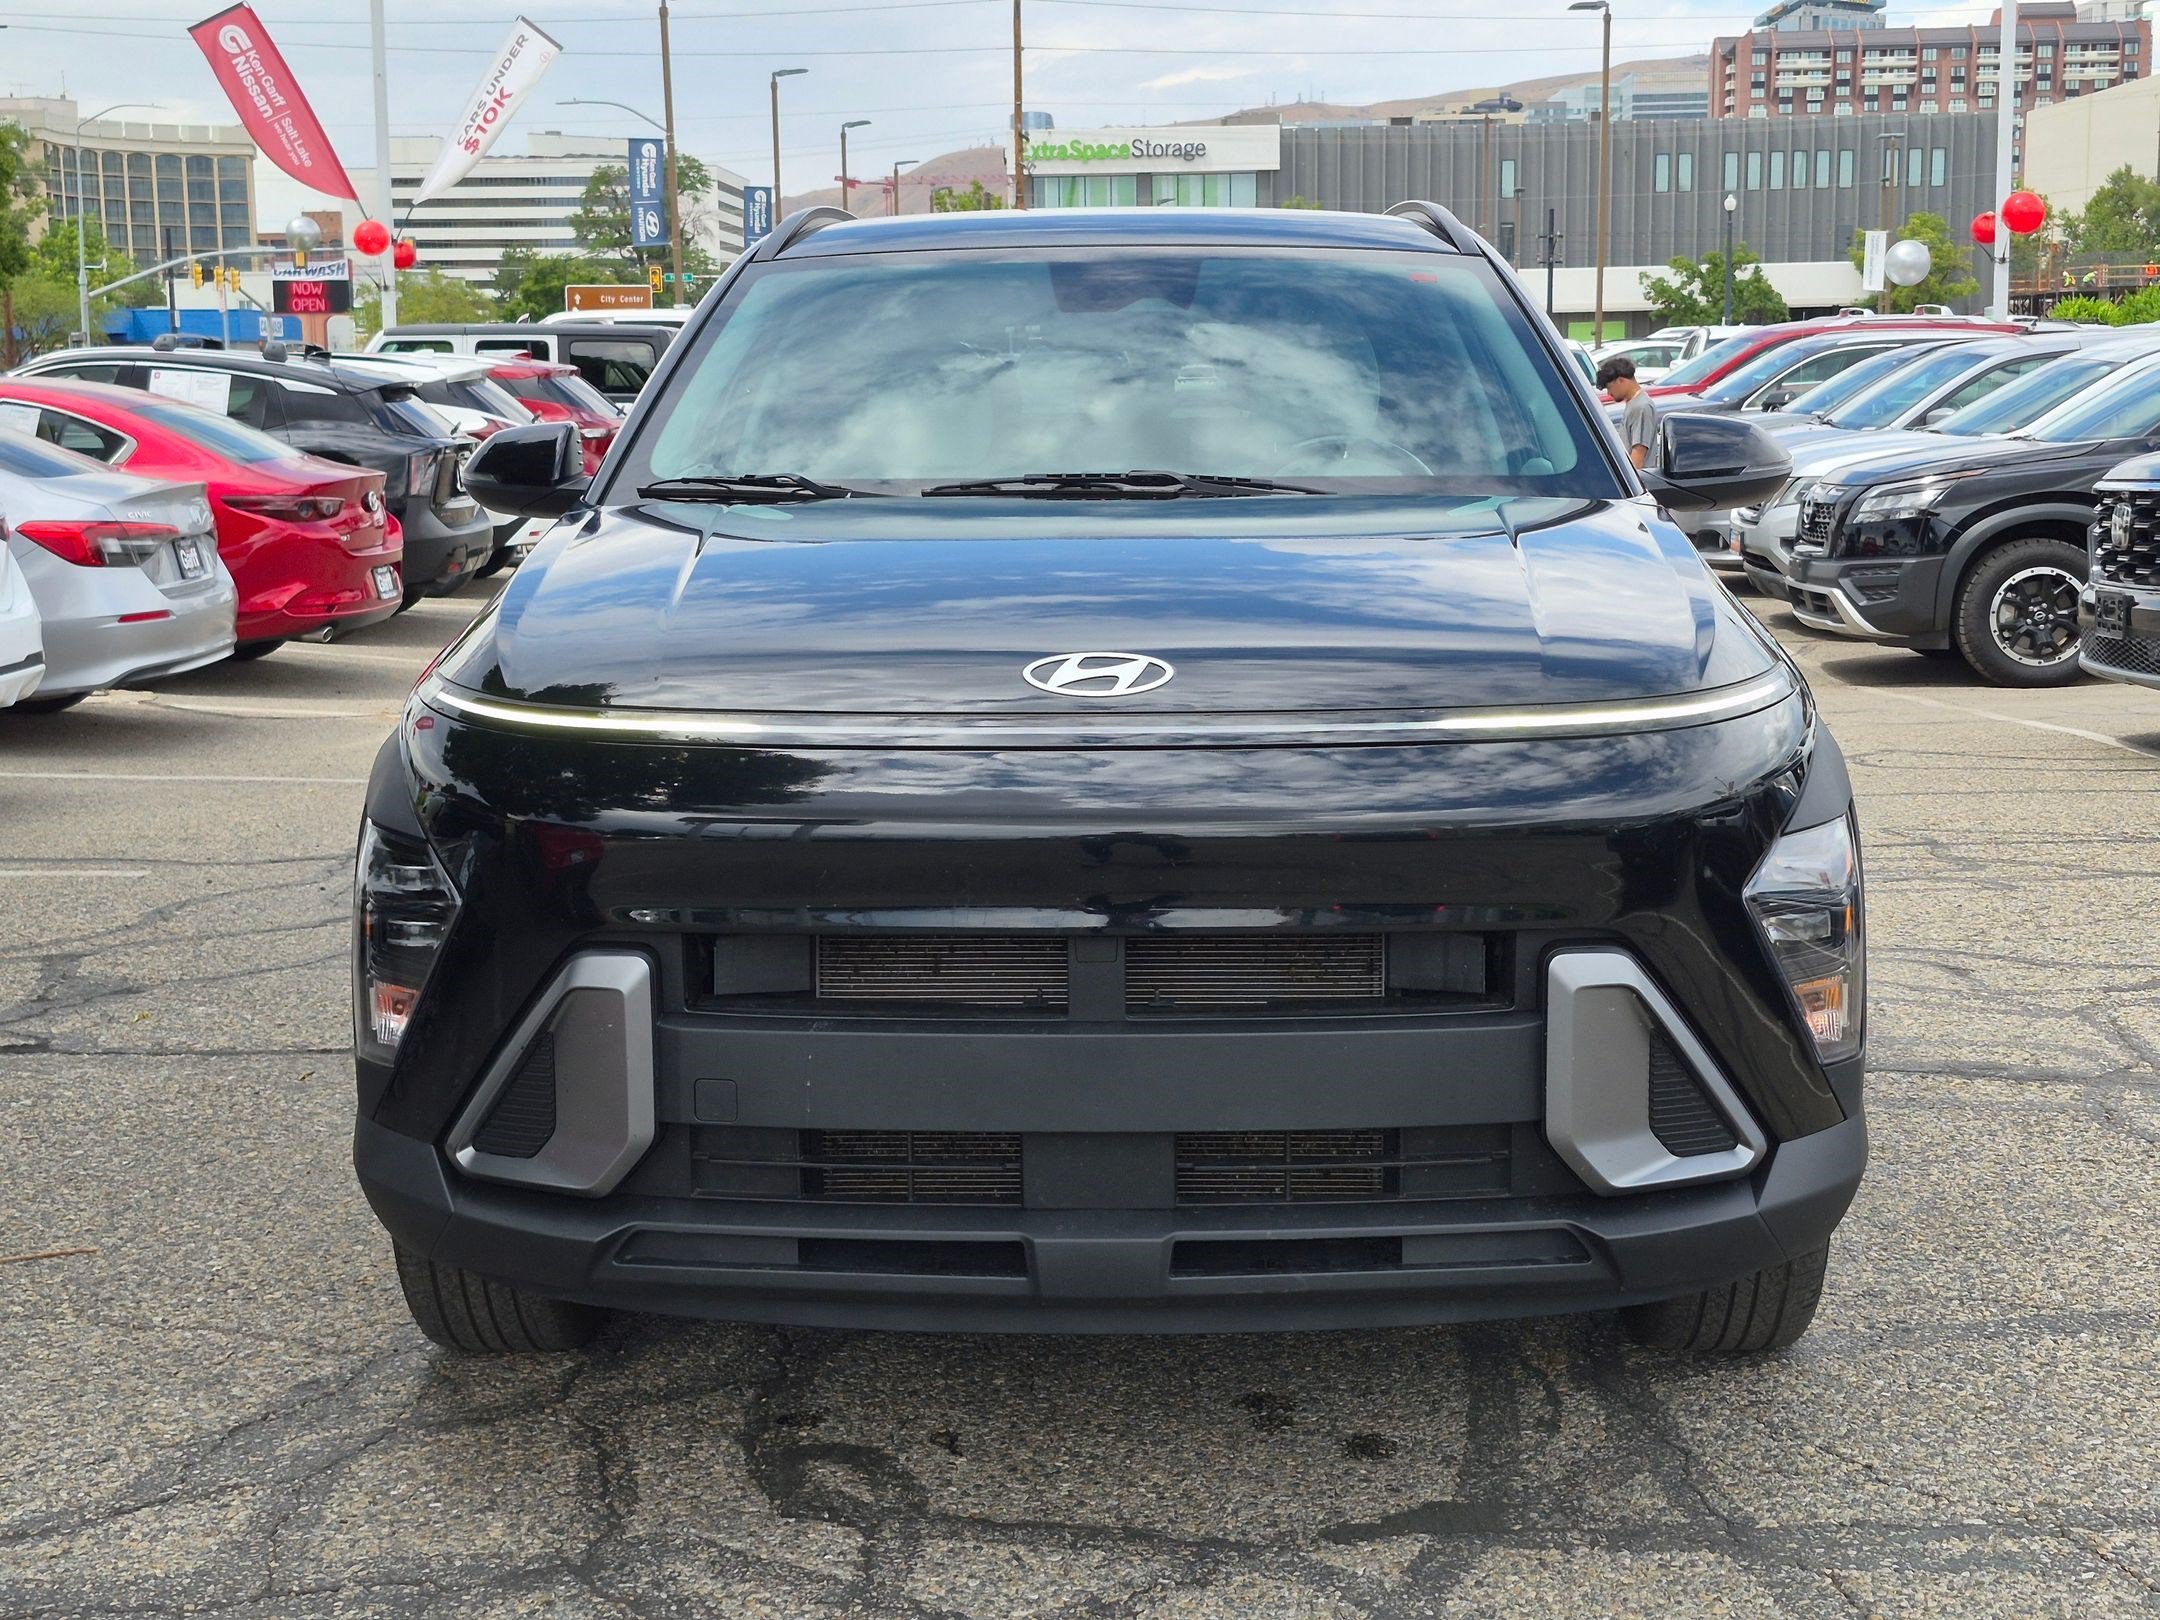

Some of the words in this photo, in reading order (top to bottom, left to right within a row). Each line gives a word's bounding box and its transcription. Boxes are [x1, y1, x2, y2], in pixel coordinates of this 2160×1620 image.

[231, 55, 274, 119] Nissan
[245, 50, 266, 77] Ken
[261, 75, 287, 109] Garff
[457, 99, 487, 146] CARS
[486, 33, 529, 96] UNDER
[464, 86, 514, 155] $10K
[278, 131, 292, 152] hear
[288, 150, 300, 166] you
[281, 116, 299, 140] Salt
[294, 136, 313, 168] Lake
[1131, 138, 1207, 161] Storage
[641, 158, 650, 197] Hyundai
[305, 263, 346, 276] WASH
[292, 282, 323, 295] NOW
[292, 298, 325, 311] OPEN
[600, 295, 616, 304] City
[619, 295, 645, 303] Center
[127, 511, 152, 519] CIVIC
